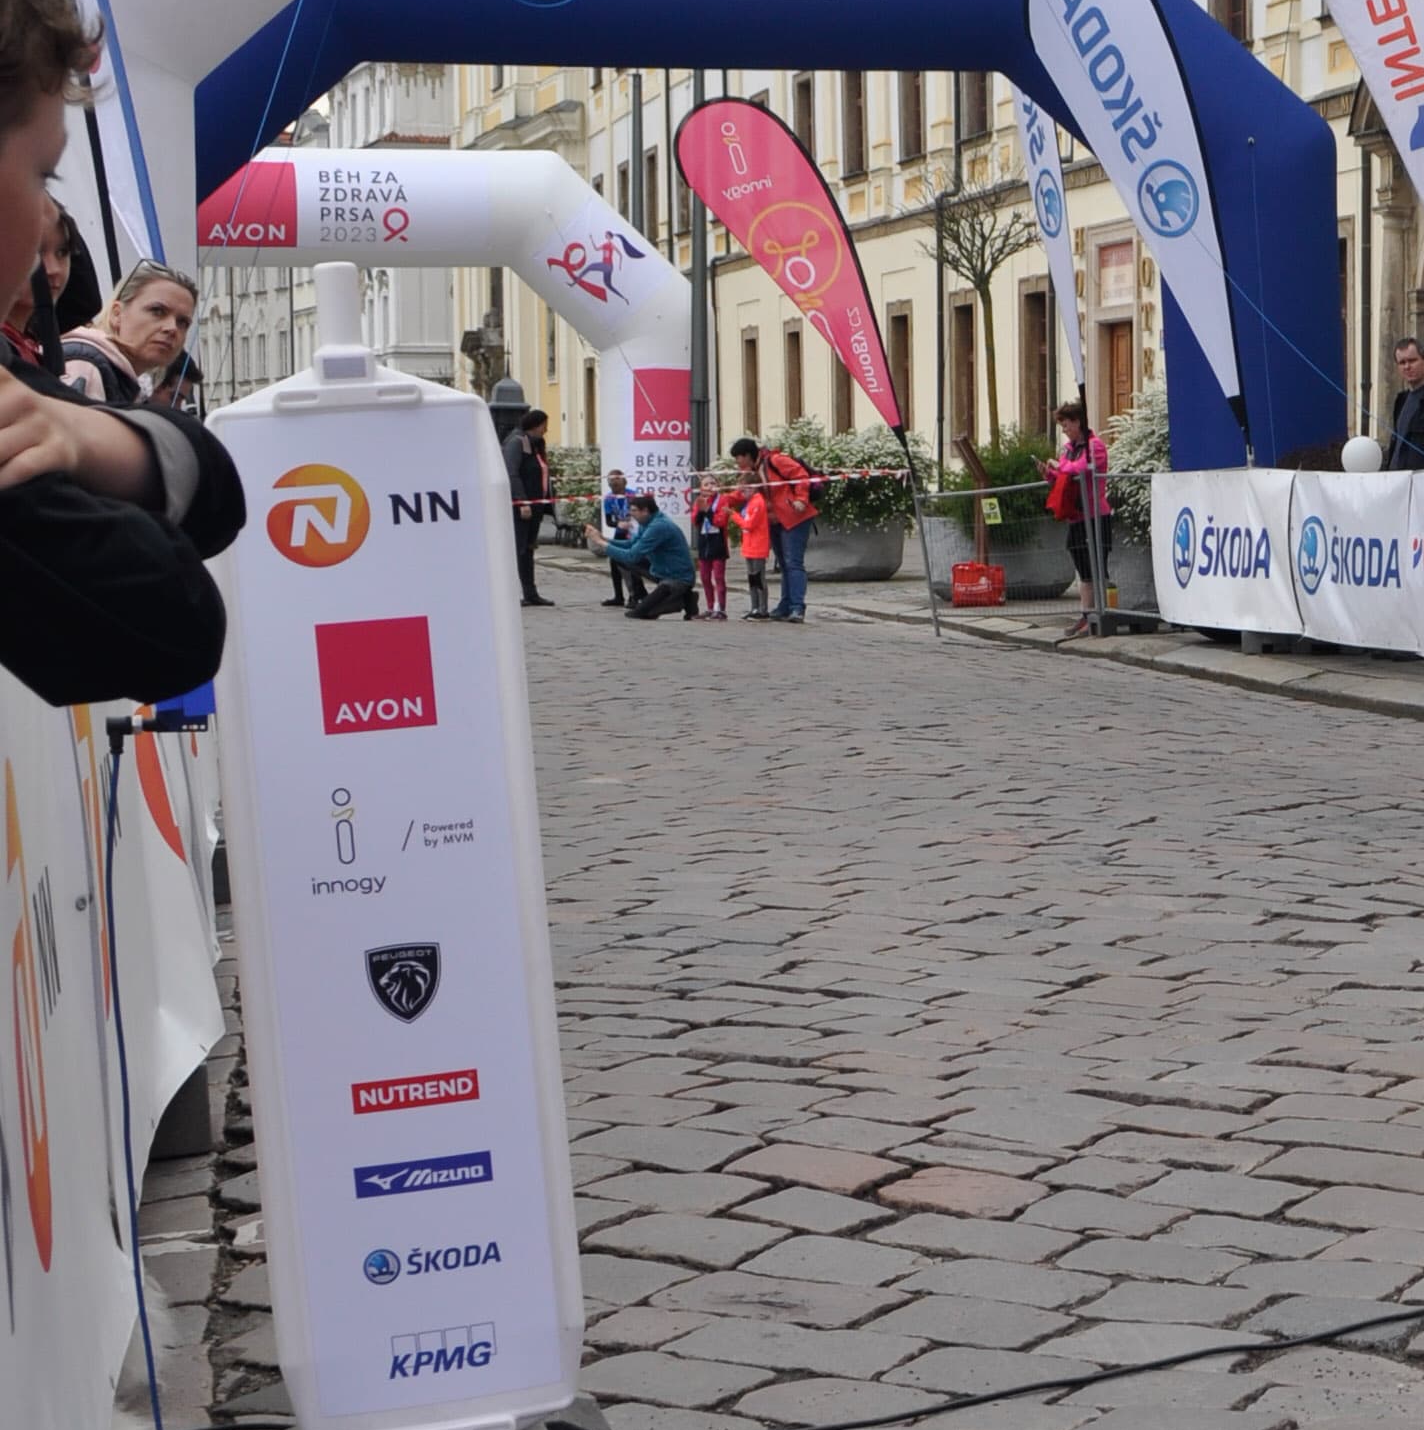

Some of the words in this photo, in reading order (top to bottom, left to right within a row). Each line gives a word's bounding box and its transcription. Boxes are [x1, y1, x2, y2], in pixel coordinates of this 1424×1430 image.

[371, 171, 399, 184] ZA
[319, 185, 408, 203] ZDRAVÁ
[320, 206, 375, 222] PRSA
[208, 223, 286, 241] AVON
[319, 226, 378, 243] 2023
[635, 471, 692, 483] ZDRAV
[388, 489, 461, 526] NN
[1198, 518, 1271, 580] ŠKODA
[1331, 525, 1401, 589] ŠKODA
[335, 696, 424, 724] AVON
[422, 819, 474, 834] Powered
[423, 836, 439, 848] by
[443, 833, 474, 845] MVM
[311, 875, 387, 895] innogy
[372, 948, 434, 963] PEUGEOT
[359, 1075, 474, 1107] NUTREND
[406, 1241, 502, 1275] ŠKODA
[388, 1340, 493, 1380] KPMG
